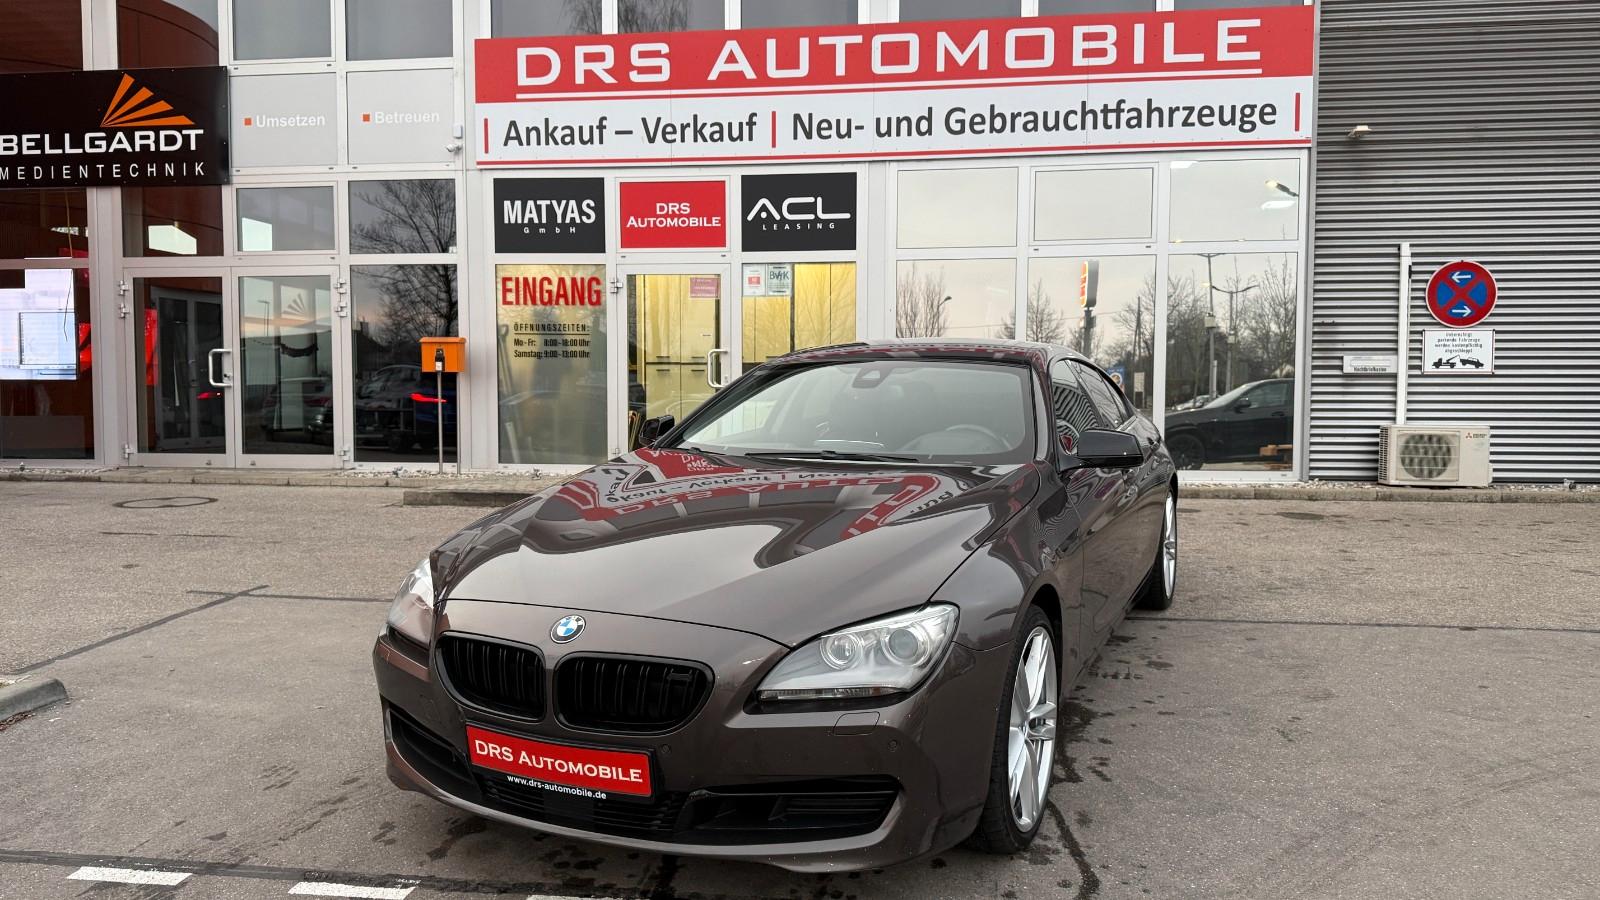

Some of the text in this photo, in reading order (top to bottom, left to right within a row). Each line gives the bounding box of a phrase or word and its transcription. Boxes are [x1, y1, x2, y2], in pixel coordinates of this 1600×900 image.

[516, 18, 1261, 86] DRS AUTOMOBILE
[256, 114, 326, 128] Umsetzen
[374, 111, 440, 124] Betreuen
[503, 116, 607, 147] Ankauf
[641, 112, 758, 145] Verkauf
[792, 112, 865, 140] Neu-
[875, 107, 933, 138] und
[944, 98, 1277, 134] Gebrauchtfahrzeuge
[0, 129, 204, 155] BELLGARDT
[0, 162, 205, 180] MEDIENTECHNIK
[504, 199, 596, 224] MATYAS
[656, 203, 690, 215] DRS
[747, 197, 851, 220] ACL
[626, 214, 721, 228] AUTOMOBILE
[762, 223, 835, 231] LEASING
[501, 276, 602, 306] EINGANG
[514, 322, 590, 332] ÖFFNUNGSZEITEN:
[579, 339, 590, 347] Uhr
[579, 350, 590, 358] Uhr
[475, 740, 643, 782] DRS AUTOMOBILE
[507, 775, 607, 799] www.drs-automobile.de
